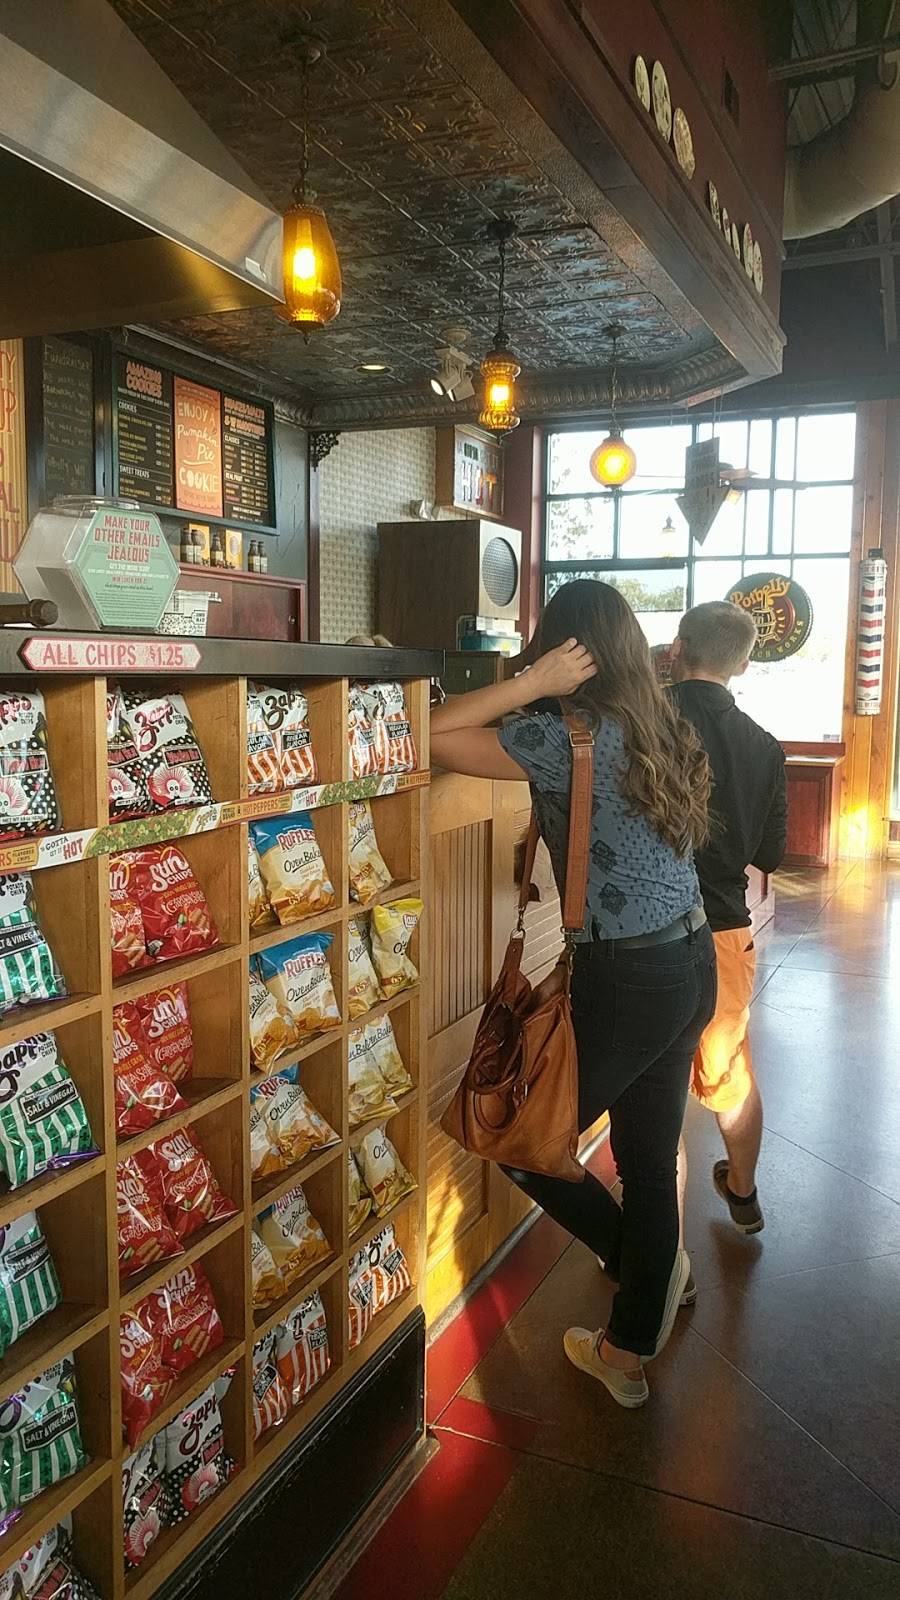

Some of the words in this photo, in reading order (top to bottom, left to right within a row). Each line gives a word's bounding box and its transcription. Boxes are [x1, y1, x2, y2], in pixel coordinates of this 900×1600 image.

[177, 402, 208, 422] ENJOY
[177, 424, 217, 447] Pumpkin
[197, 443, 216, 461] Pie
[134, 468, 150, 479] TREATS
[179, 466, 219, 493] COOKIE
[104, 515, 127, 529] MAKE
[130, 519, 149, 531] YOUR
[94, 528, 125, 545] OTHER
[128, 533, 160, 547] EMAILS
[107, 545, 149, 563] JEALOUS
[731, 577, 790, 608] Potbelly
[776, 619, 804, 653] WORKS
[42, 643, 79, 665] ALL
[86, 643, 137, 666] CHIPS
[149, 645, 184, 666] $1.25
[253, 799, 279, 813] PEPPERS
[45, 835, 69, 851] GOTTA
[63, 837, 83, 860] HOT
[277, 828, 316, 850] RUFFLES
[284, 855, 305, 873] Oven
[305, 848, 321, 863] Bake
[149, 855, 190, 892] Sun
[167, 868, 194, 885] CHIPS
[6, 937, 13, 947] &
[284, 951, 326, 978] RUFFLES
[376, 1023, 393, 1038] Bake
[27, 1102, 44, 1118] SALT
[50, 1086, 74, 1105] VINEGAR
[290, 1088, 303, 1104] Bake
[161, 1134, 192, 1172] Sun
[25, 1430, 44, 1444] SALT
[49, 1412, 75, 1433] VINEGAR
